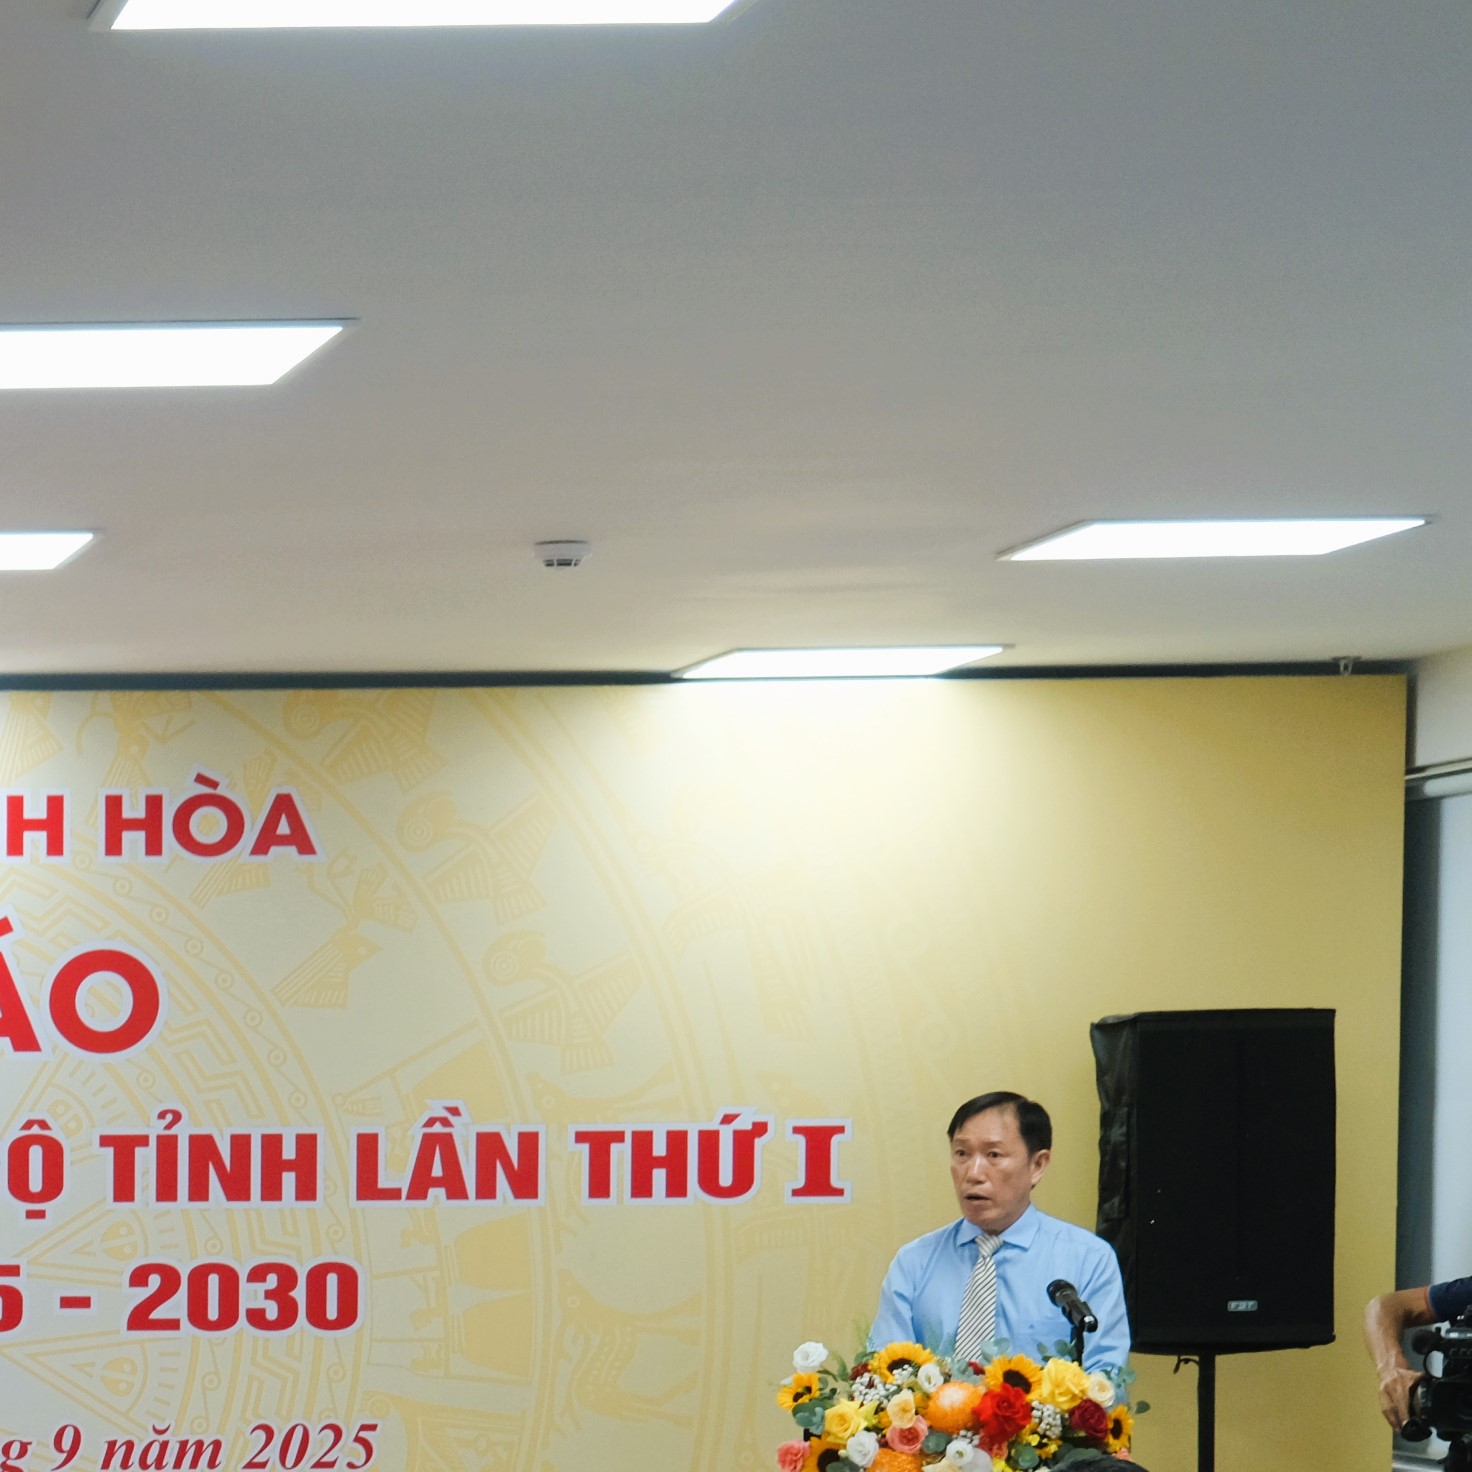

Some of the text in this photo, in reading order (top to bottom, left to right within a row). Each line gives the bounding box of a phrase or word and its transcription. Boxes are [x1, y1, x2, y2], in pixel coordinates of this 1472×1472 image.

[105, 774, 316, 857] HÒA
[99, 1109, 318, 1203] TỈNH
[356, 1102, 540, 1201] LẦN
[575, 1110, 769, 1199] THỨ
[792, 1125, 846, 1197] I
[127, 1261, 359, 1332] 2030
[53, 1424, 83, 1470] 9
[100, 1427, 224, 1472] năm
[244, 1423, 379, 1471] 2025
